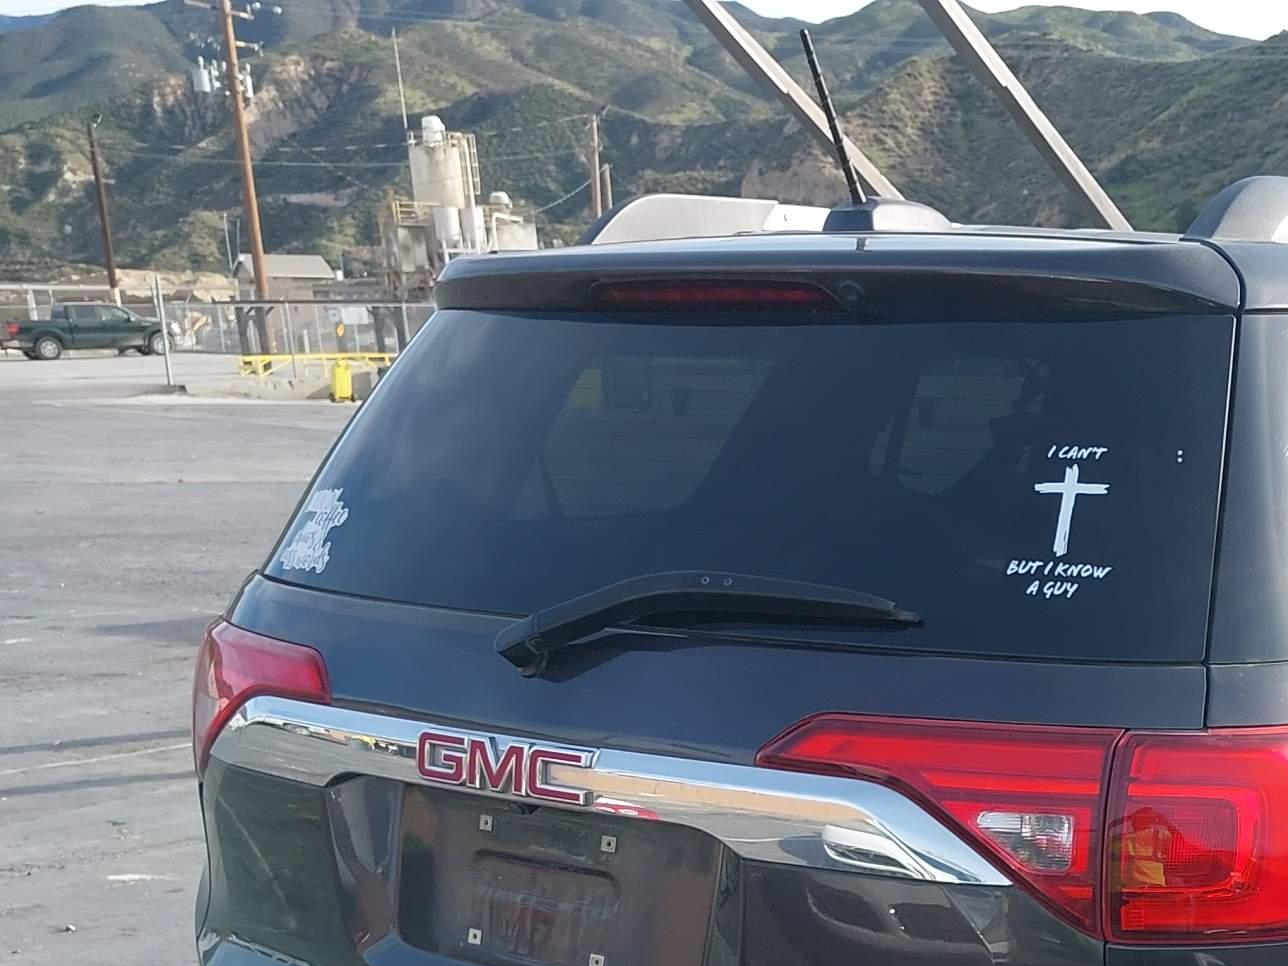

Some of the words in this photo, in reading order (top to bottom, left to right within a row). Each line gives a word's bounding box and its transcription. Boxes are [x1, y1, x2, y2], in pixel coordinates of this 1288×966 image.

[1047, 445, 1056, 458] I
[1058, 445, 1108, 459] CAN'T
[1006, 560, 1044, 576] BUT
[1044, 561, 1053, 575] I
[1054, 562, 1112, 578] KNOW
[1026, 580, 1040, 596] A
[1043, 581, 1078, 598] GUY
[416, 728, 595, 806] GMC
